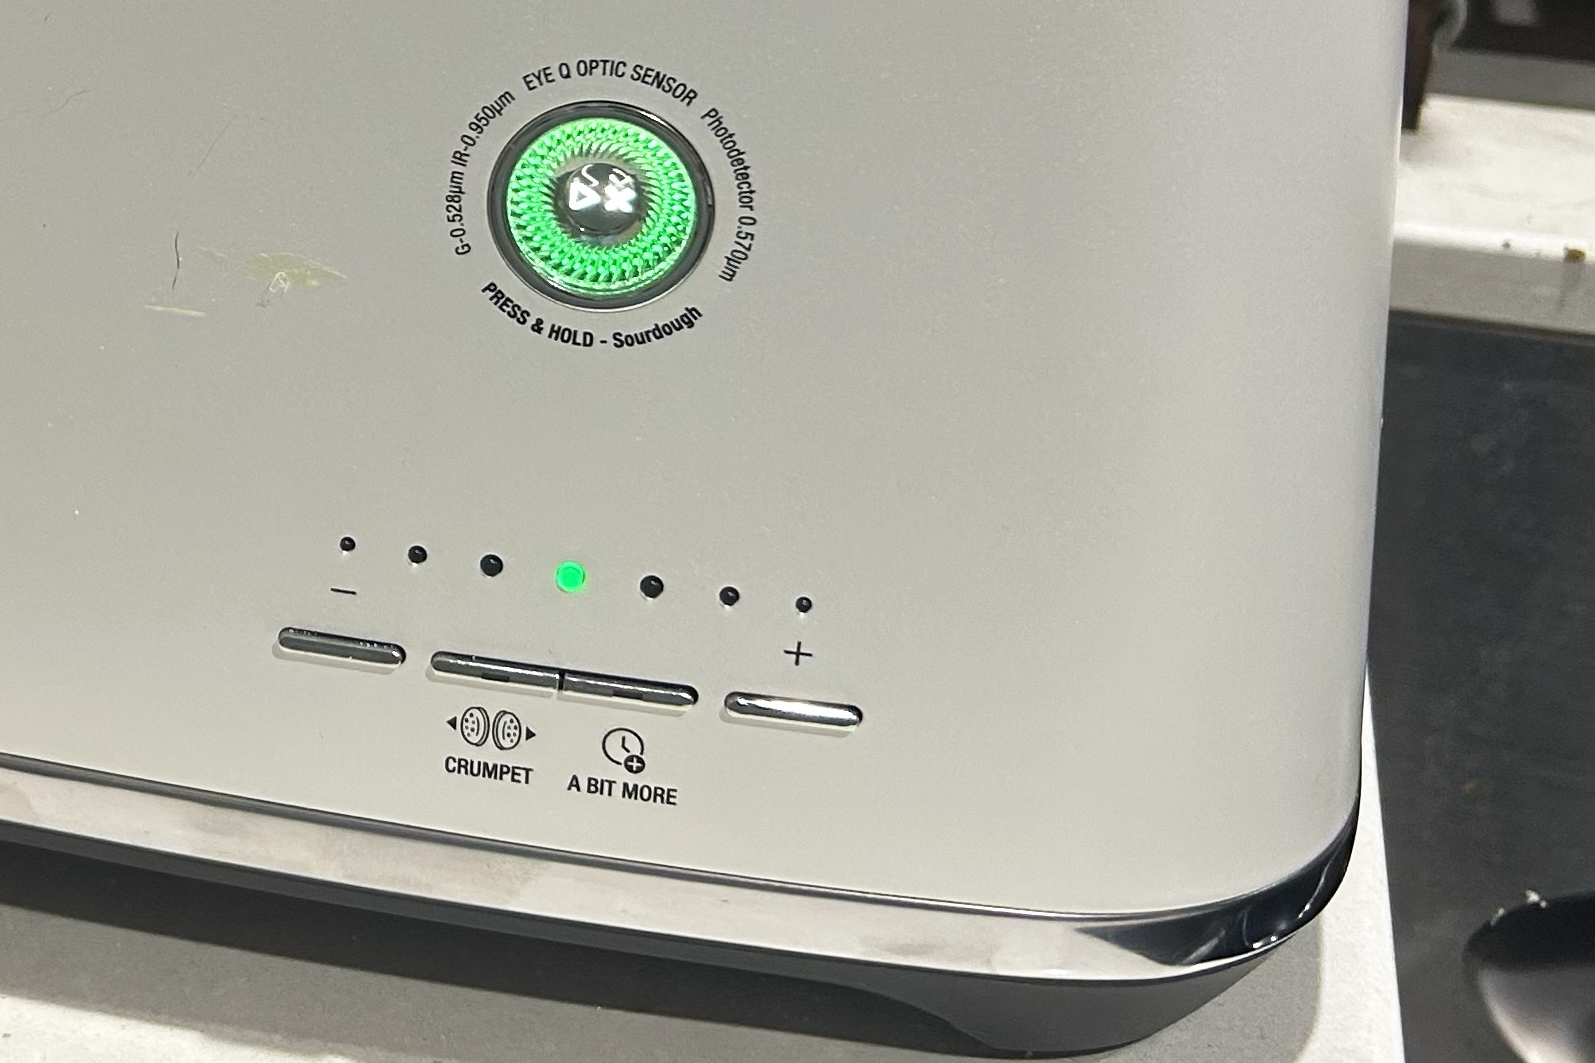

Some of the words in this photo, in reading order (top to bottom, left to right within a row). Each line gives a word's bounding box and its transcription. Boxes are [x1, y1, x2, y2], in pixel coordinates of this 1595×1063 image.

[522, 66, 555, 92] EYE
[558, 63, 571, 80] Q
[576, 59, 627, 78] OPTIC
[630, 64, 698, 107] SENSOR
[701, 107, 755, 210] Photodetector
[481, 282, 530, 326] PRESS
[530, 318, 544, 335] &
[548, 324, 594, 348] HOLD
[612, 305, 703, 349] Sourdough
[444, 756, 534, 786] CRUMPET
[567, 774, 582, 794] A
[585, 776, 617, 799] BIT
[621, 781, 678, 806] MORE
